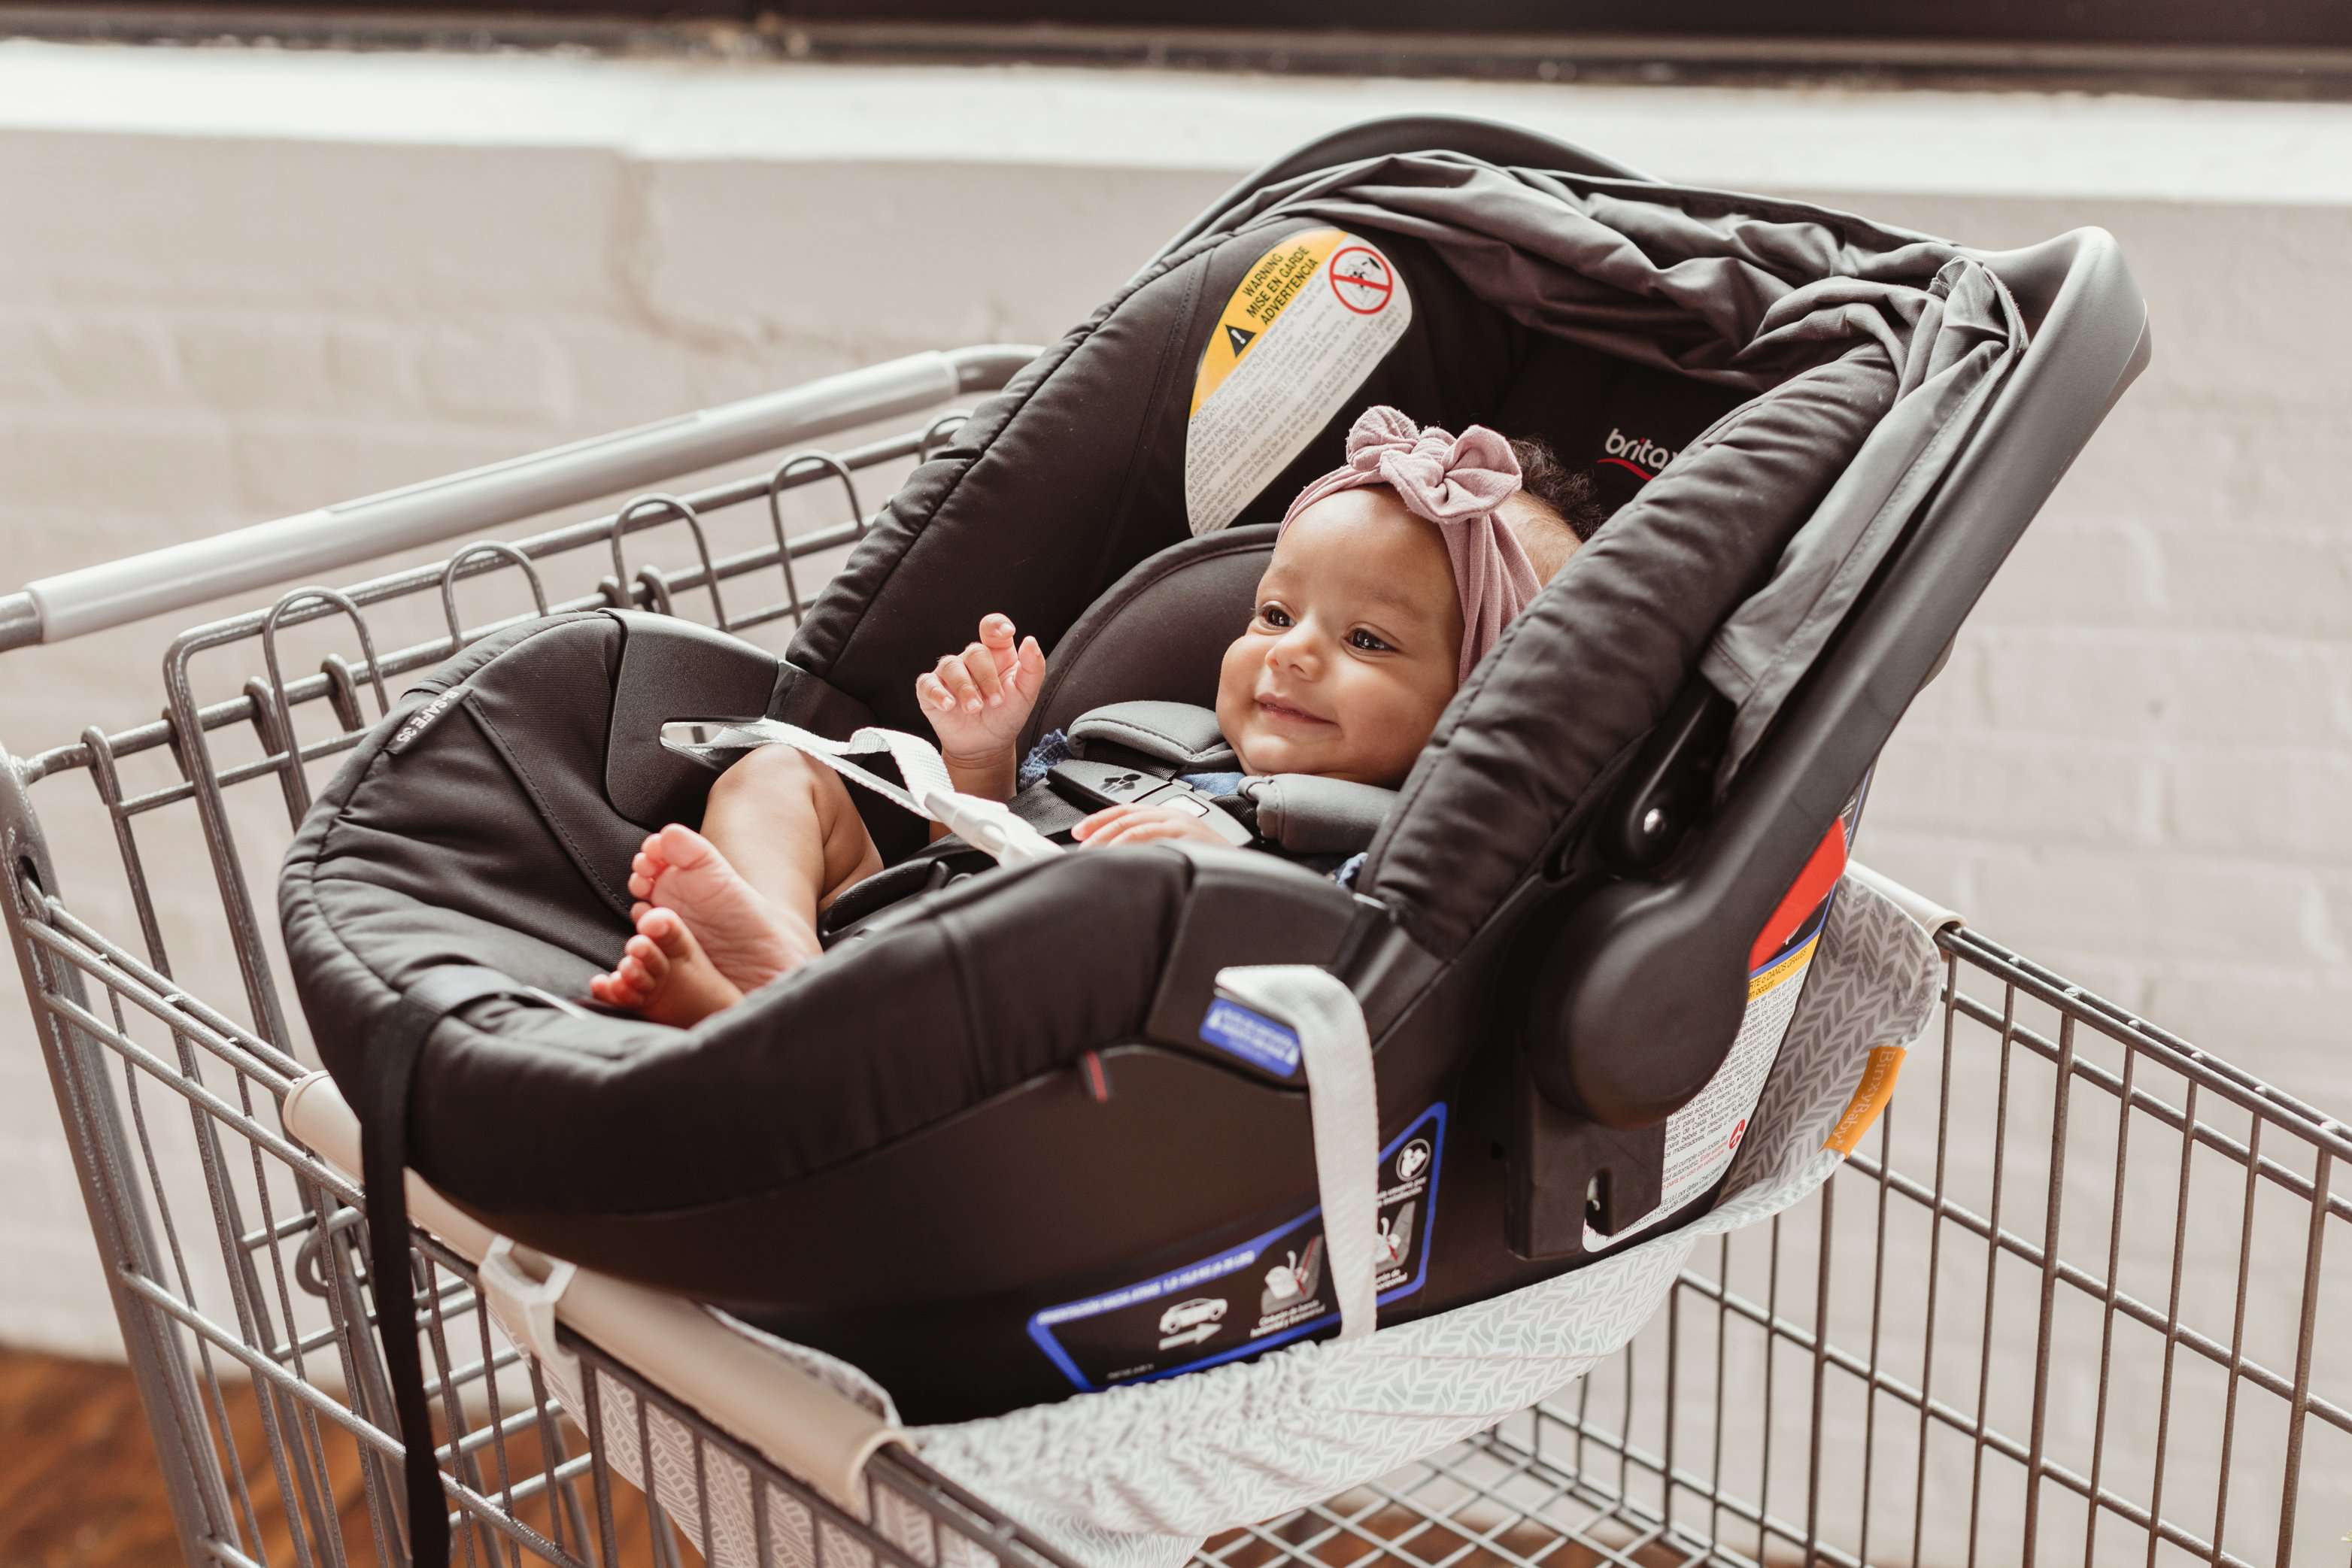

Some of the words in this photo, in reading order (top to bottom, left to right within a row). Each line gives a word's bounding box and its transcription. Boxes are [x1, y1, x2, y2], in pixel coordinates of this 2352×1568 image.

[1242, 253, 1283, 297] WARNING
[1246, 290, 1271, 318] MISE
[1267, 275, 1284, 294] EN
[1278, 245, 1310, 279] GARDE
[1260, 258, 1319, 326] ADVERTENCIA
[1604, 427, 1679, 469] brita
[411, 690, 460, 729] B-SAFE
[396, 726, 417, 743] 35
